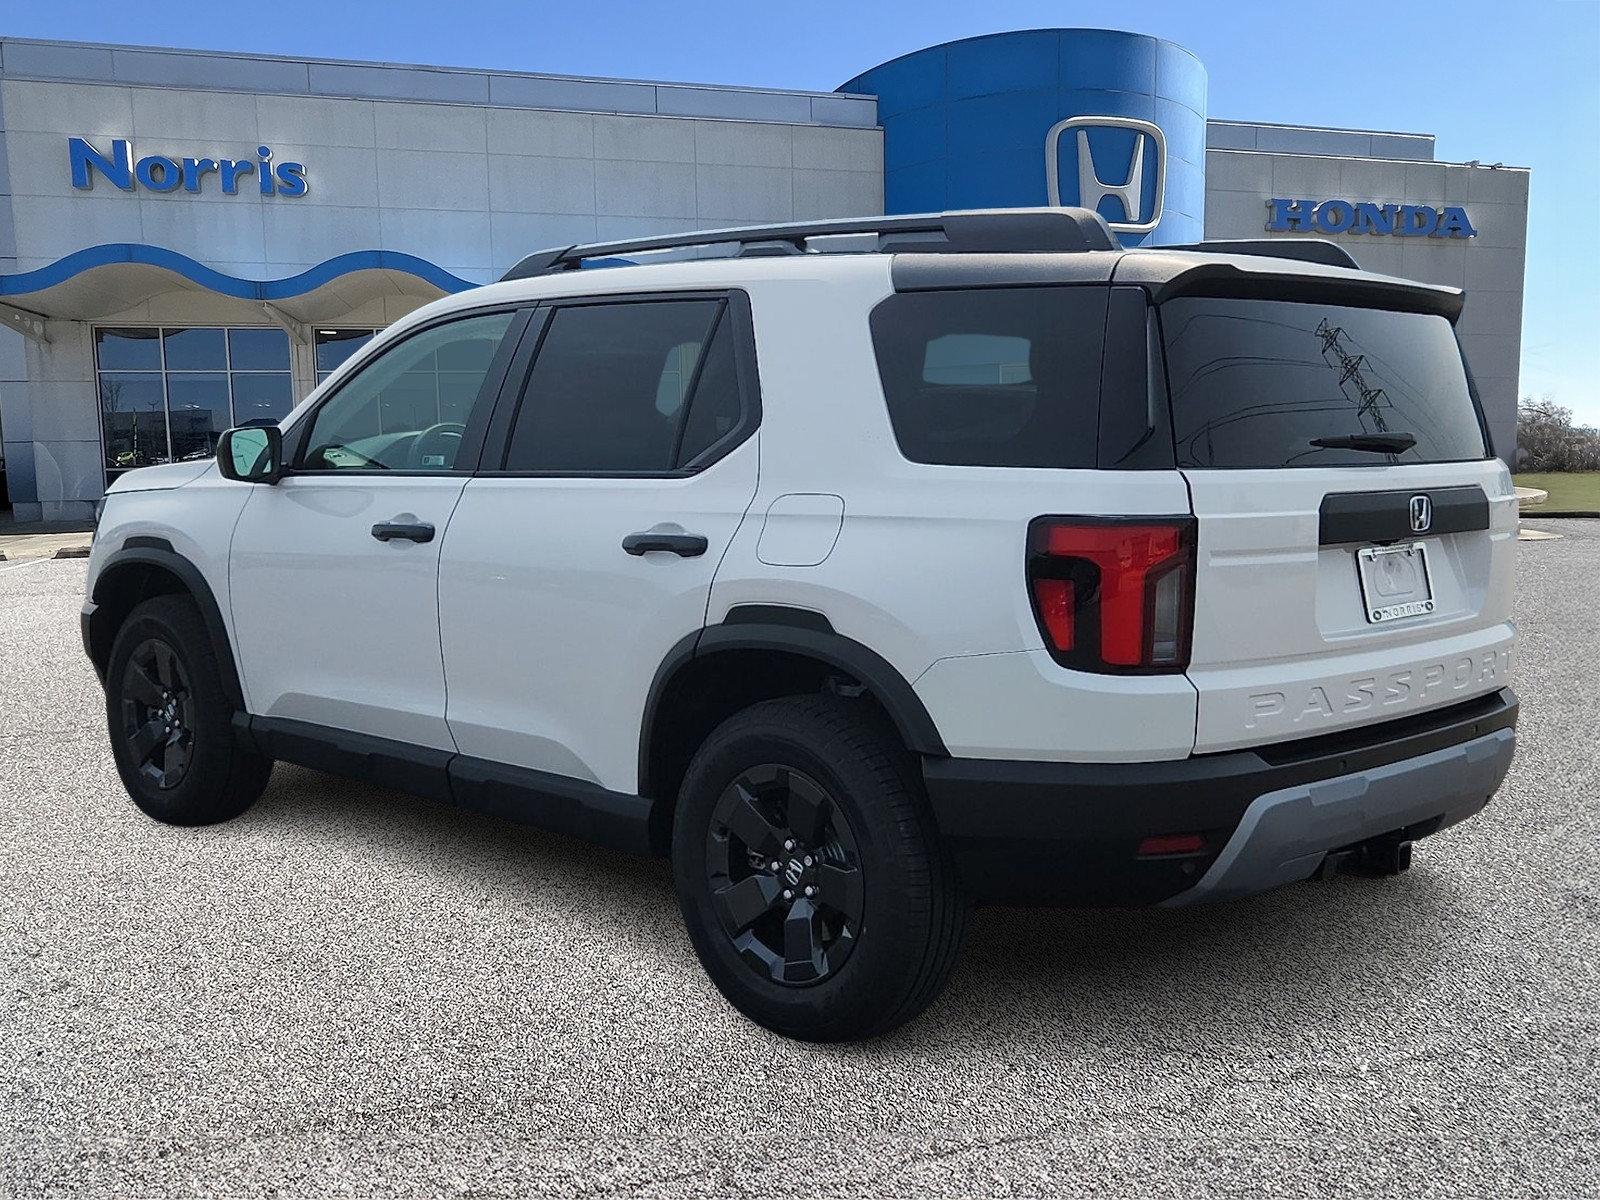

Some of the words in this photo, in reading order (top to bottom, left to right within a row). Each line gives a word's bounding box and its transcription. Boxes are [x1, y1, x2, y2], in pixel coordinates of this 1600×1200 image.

[68, 137, 309, 196] Norris
[1266, 198, 1478, 238] HONDA
[1384, 603, 1422, 618] NORRIS
[1245, 645, 1515, 728] PASSPORT
